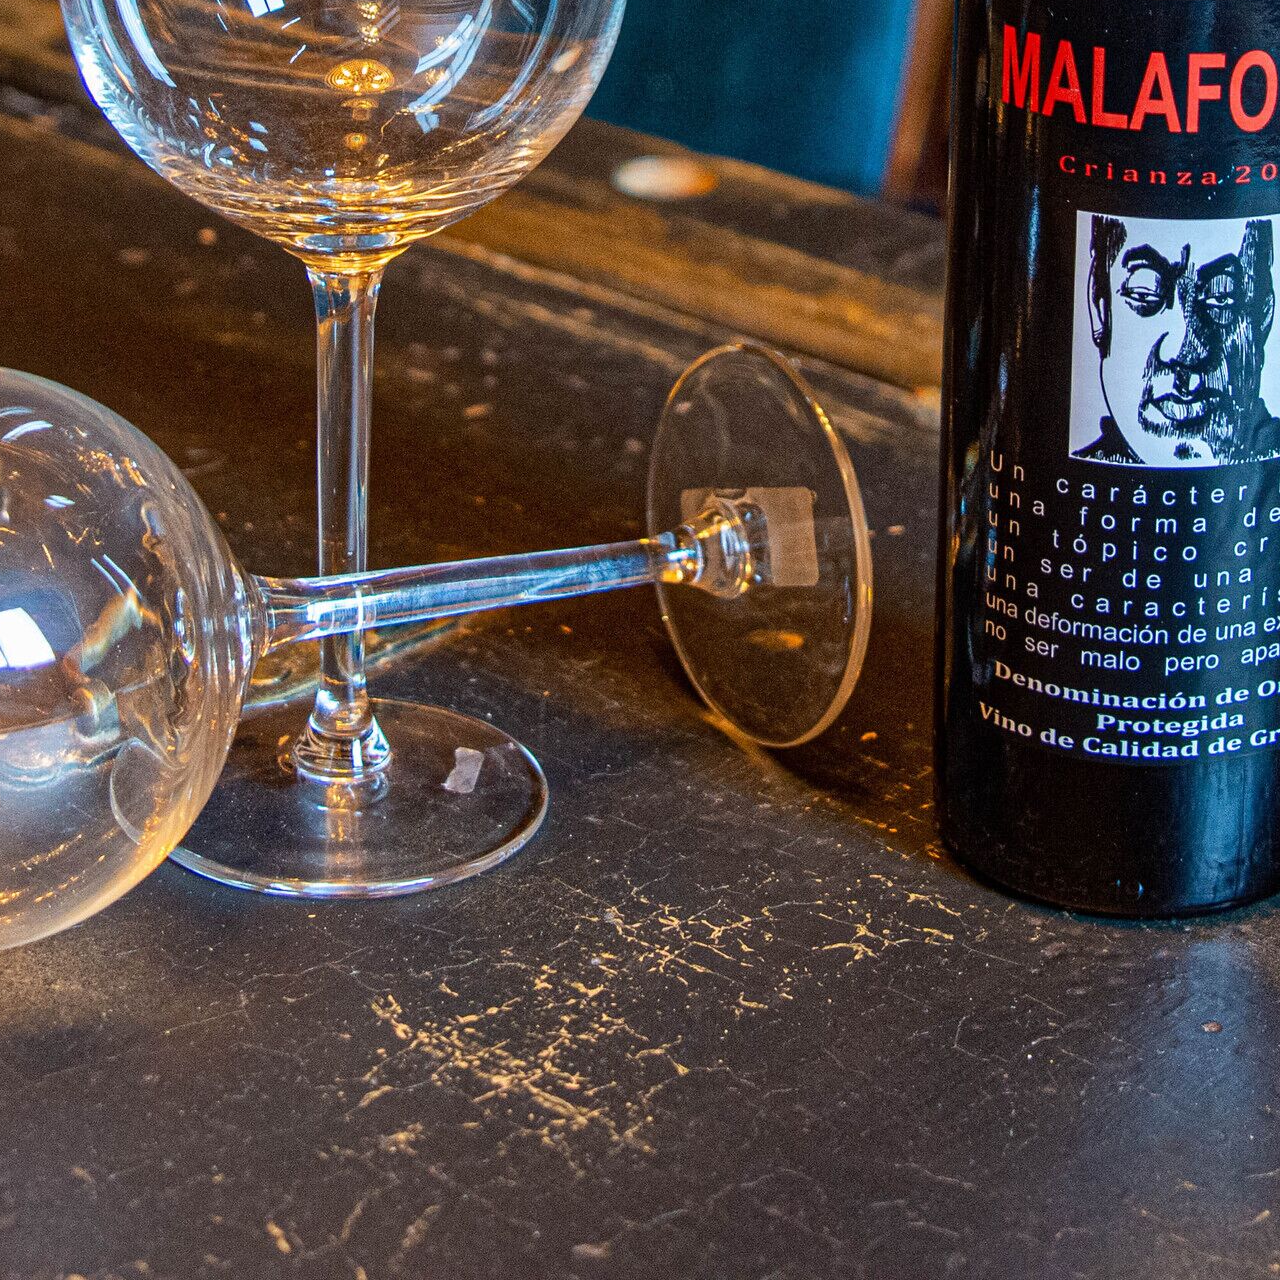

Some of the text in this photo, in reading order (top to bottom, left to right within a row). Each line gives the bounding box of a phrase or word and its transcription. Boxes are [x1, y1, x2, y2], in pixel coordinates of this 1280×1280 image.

[1059, 154, 1217, 185] Crianza
[991, 450, 1024, 481] Un
[1056, 478, 1247, 505] carácter
[989, 483, 1045, 516] una
[1079, 506, 1206, 533] forma
[988, 510, 1020, 536] un
[1052, 529, 1197, 562] tópico
[987, 538, 1015, 562] un
[1041, 558, 1092, 582] ser
[1122, 568, 1161, 588] de
[1194, 567, 1251, 588] una
[987, 566, 1038, 597] una
[985, 592, 1018, 619] una
[1024, 606, 1169, 644] deformación
[1177, 624, 1207, 644] de
[1215, 620, 1256, 641] una
[985, 619, 1007, 641] no
[1024, 636, 1059, 658] ser
[1081, 650, 1140, 671] malo
[1165, 653, 1219, 676] pero
[994, 659, 1206, 709] Denominación
[1215, 687, 1250, 705] de
[979, 700, 1033, 737] Vino
[1039, 728, 1075, 749] de
[1082, 736, 1199, 758] Calidad
[1207, 736, 1242, 755] de
[1096, 712, 1245, 737] Protegida
